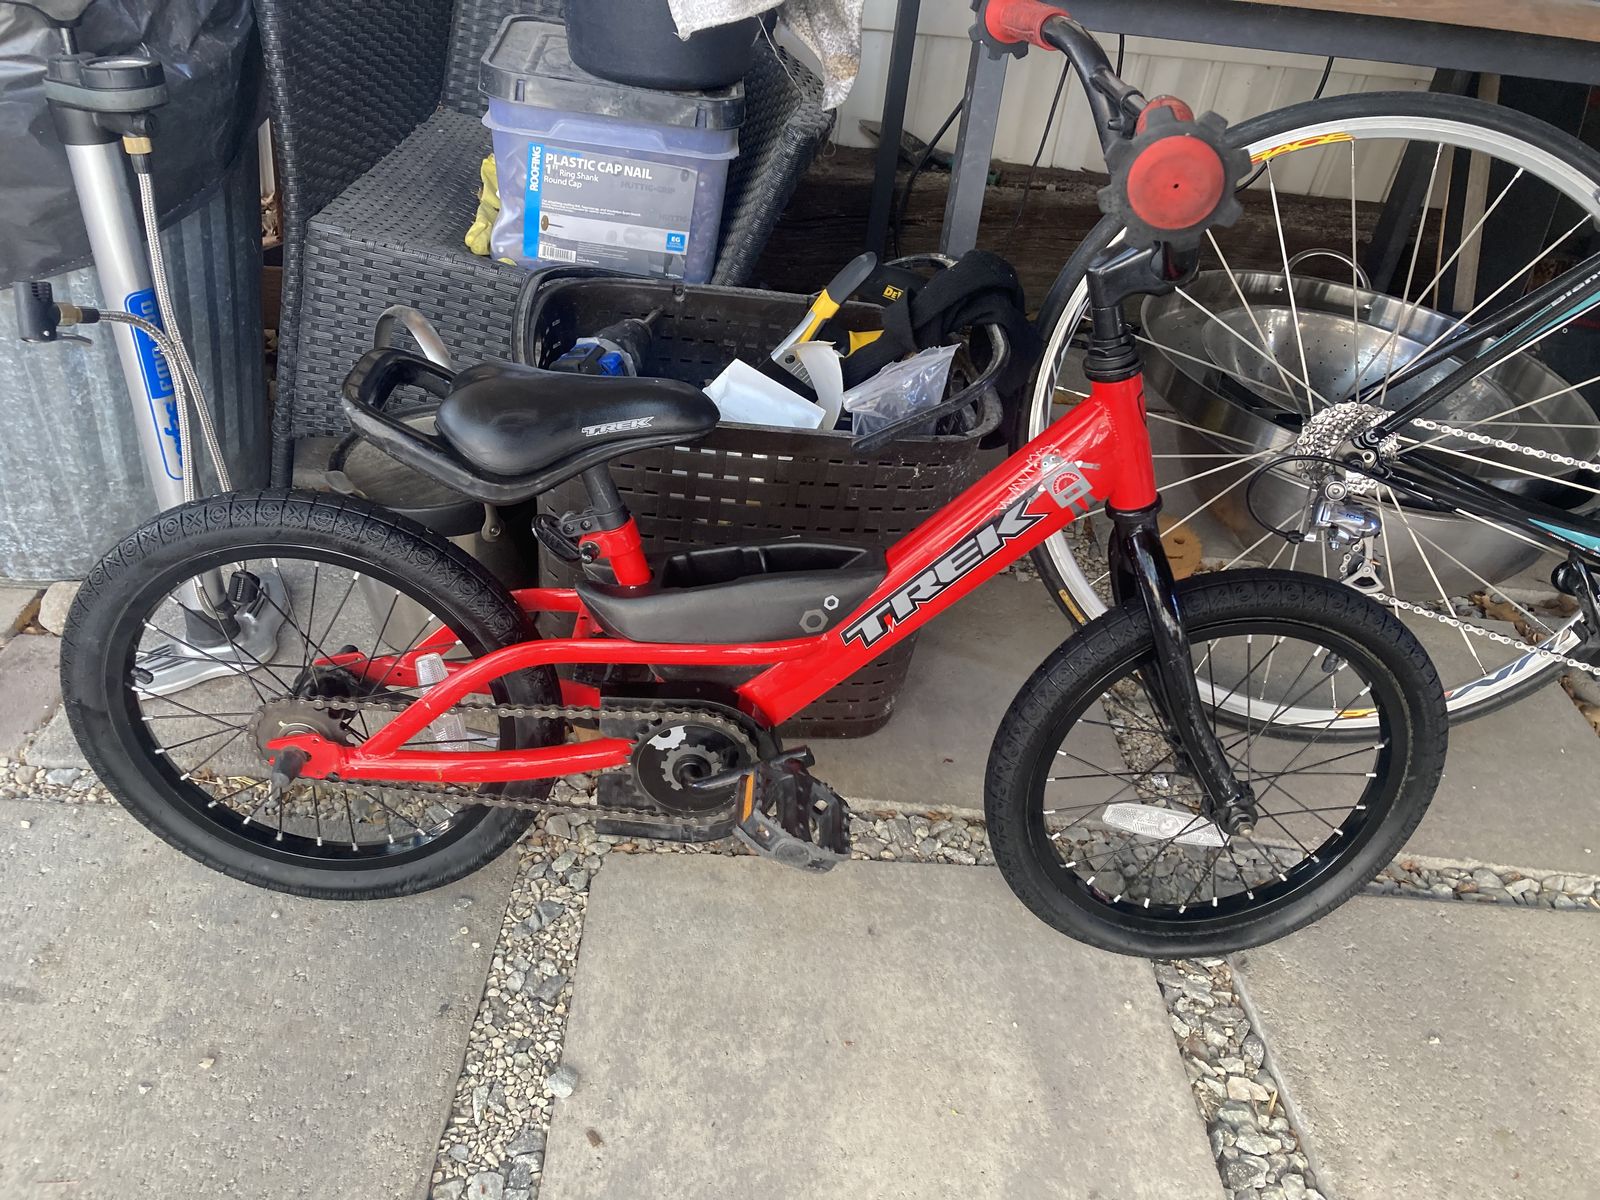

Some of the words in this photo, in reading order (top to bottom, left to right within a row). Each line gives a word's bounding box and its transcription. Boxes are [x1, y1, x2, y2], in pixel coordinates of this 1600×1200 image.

[529, 145, 542, 192] ROOFING
[545, 152, 596, 171] PLASTIC
[597, 161, 623, 175] CAP
[624, 165, 653, 180] NAIL
[559, 168, 576, 179] Ring
[576, 171, 599, 183] Shank
[543, 175, 568, 186] Round
[568, 179, 583, 189] Cap
[581, 416, 655, 437] TREK
[841, 499, 1046, 648] TREK
